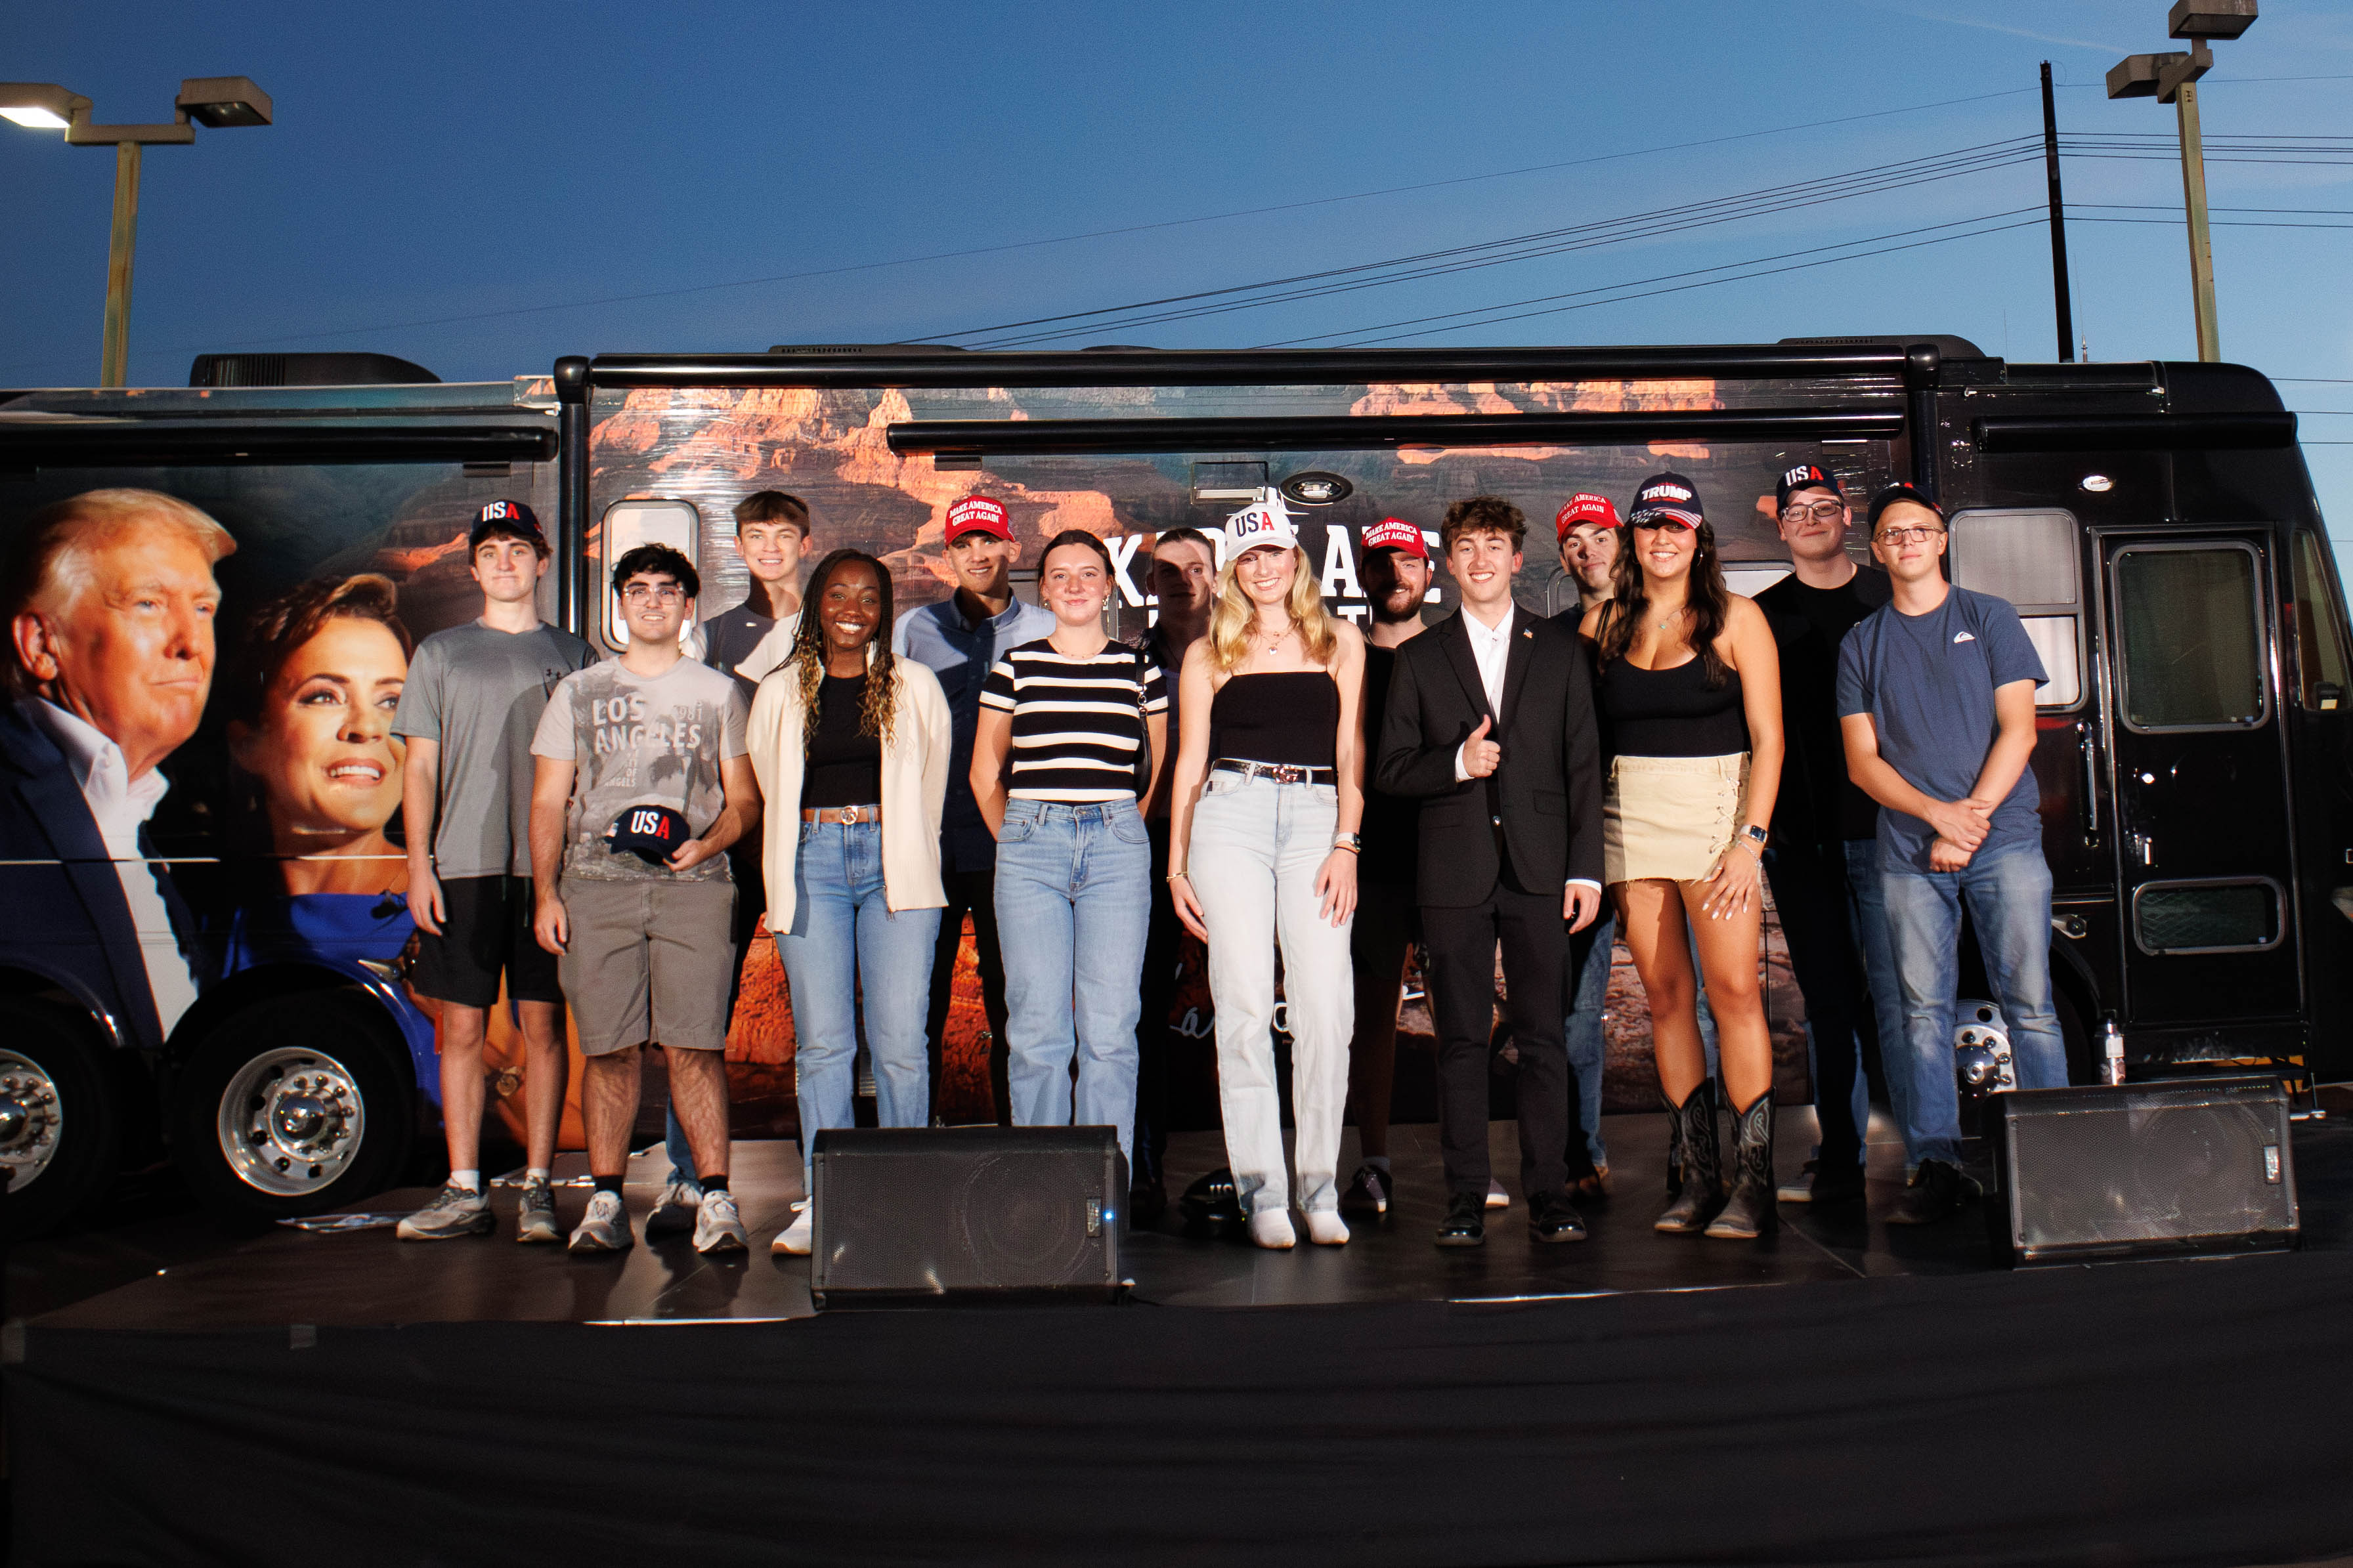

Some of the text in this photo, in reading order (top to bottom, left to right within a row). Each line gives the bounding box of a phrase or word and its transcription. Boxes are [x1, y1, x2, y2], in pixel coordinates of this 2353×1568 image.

[1785, 465, 1824, 486] USA
[1574, 494, 1607, 504] AMERICA
[1641, 485, 1692, 501] TRUMP
[482, 501, 520, 522] USA
[949, 501, 1003, 519] MAKE AMERICA
[952, 510, 999, 526] GREAT AGAIN
[1561, 503, 1605, 524] GREAT AGAIN
[1235, 511, 1275, 538] USA
[1365, 522, 1418, 540] MAKE AMERICA
[1368, 531, 1414, 547] GREAT AGAIN
[592, 691, 645, 727] LOS
[630, 811, 670, 840] USA
